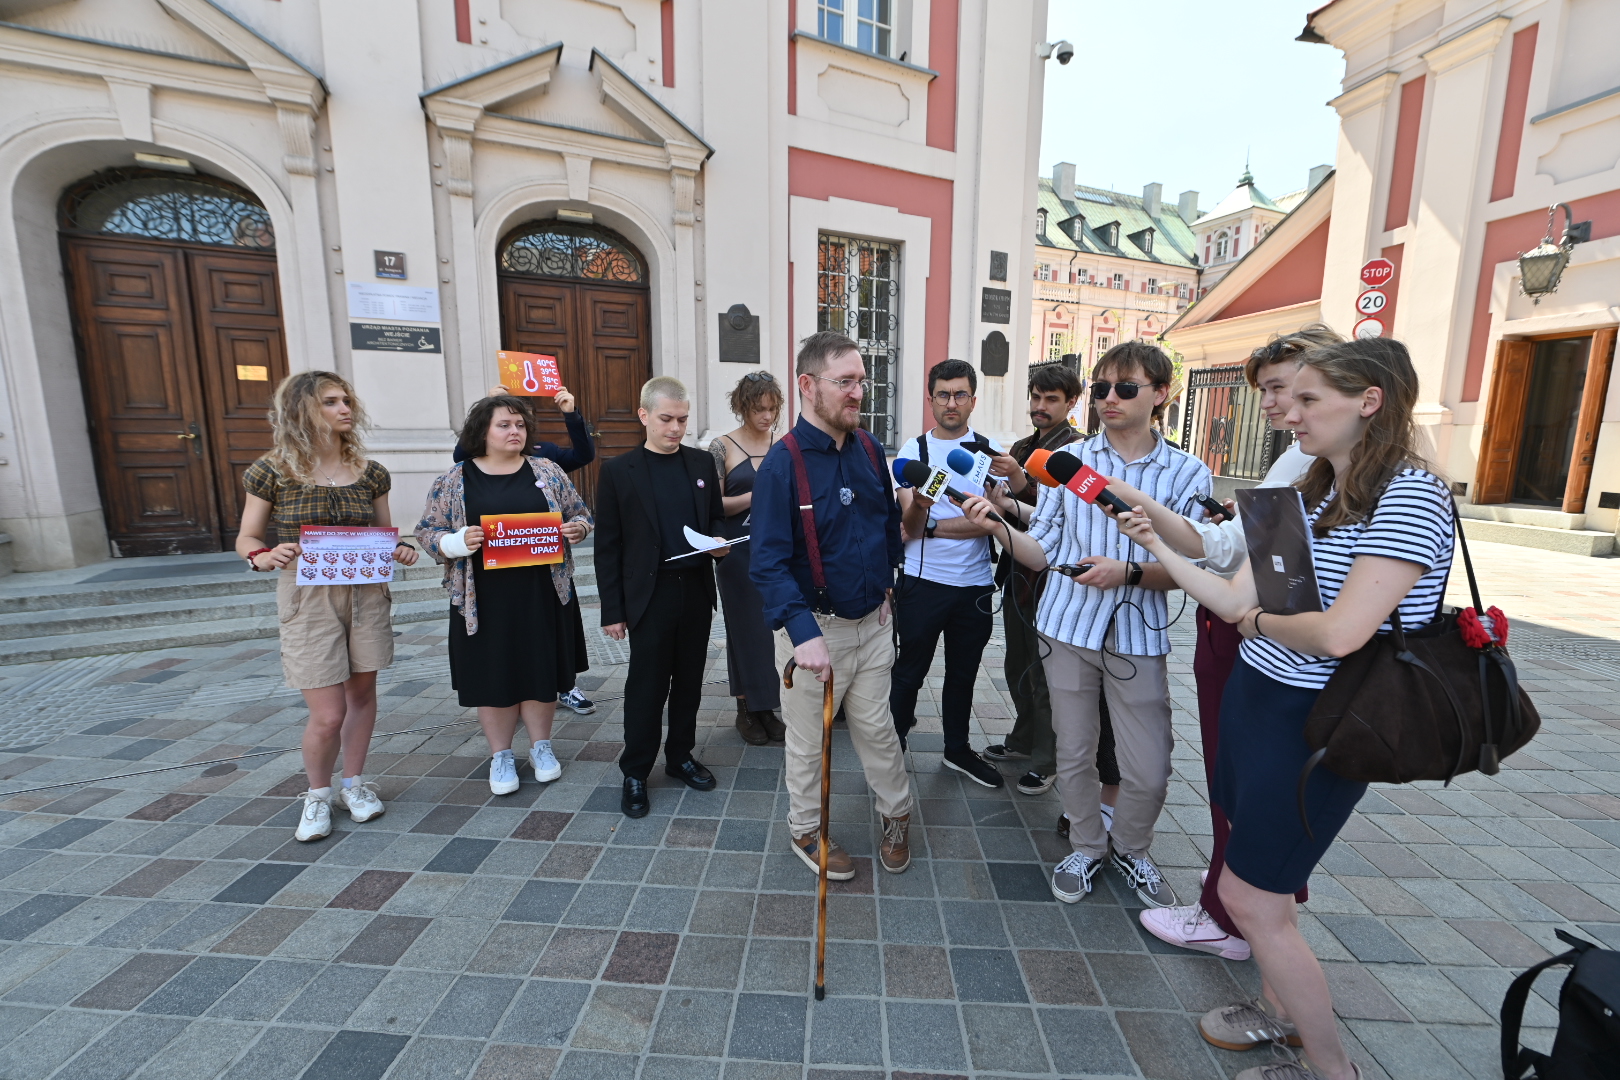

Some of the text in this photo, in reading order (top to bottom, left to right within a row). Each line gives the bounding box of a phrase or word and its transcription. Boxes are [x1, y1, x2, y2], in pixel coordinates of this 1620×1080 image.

[384, 256, 396, 266] 17
[1363, 267, 1390, 278] STOP
[1362, 296, 1384, 309] 20
[537, 359, 556, 367] 40°C
[542, 376, 558, 384] 38°C
[973, 454, 987, 483] EMAUS
[508, 527, 558, 536] NADCHODZĄ
[488, 536, 559, 547] NIEBEZPIECZNE
[531, 545, 559, 554] UPAŁY
